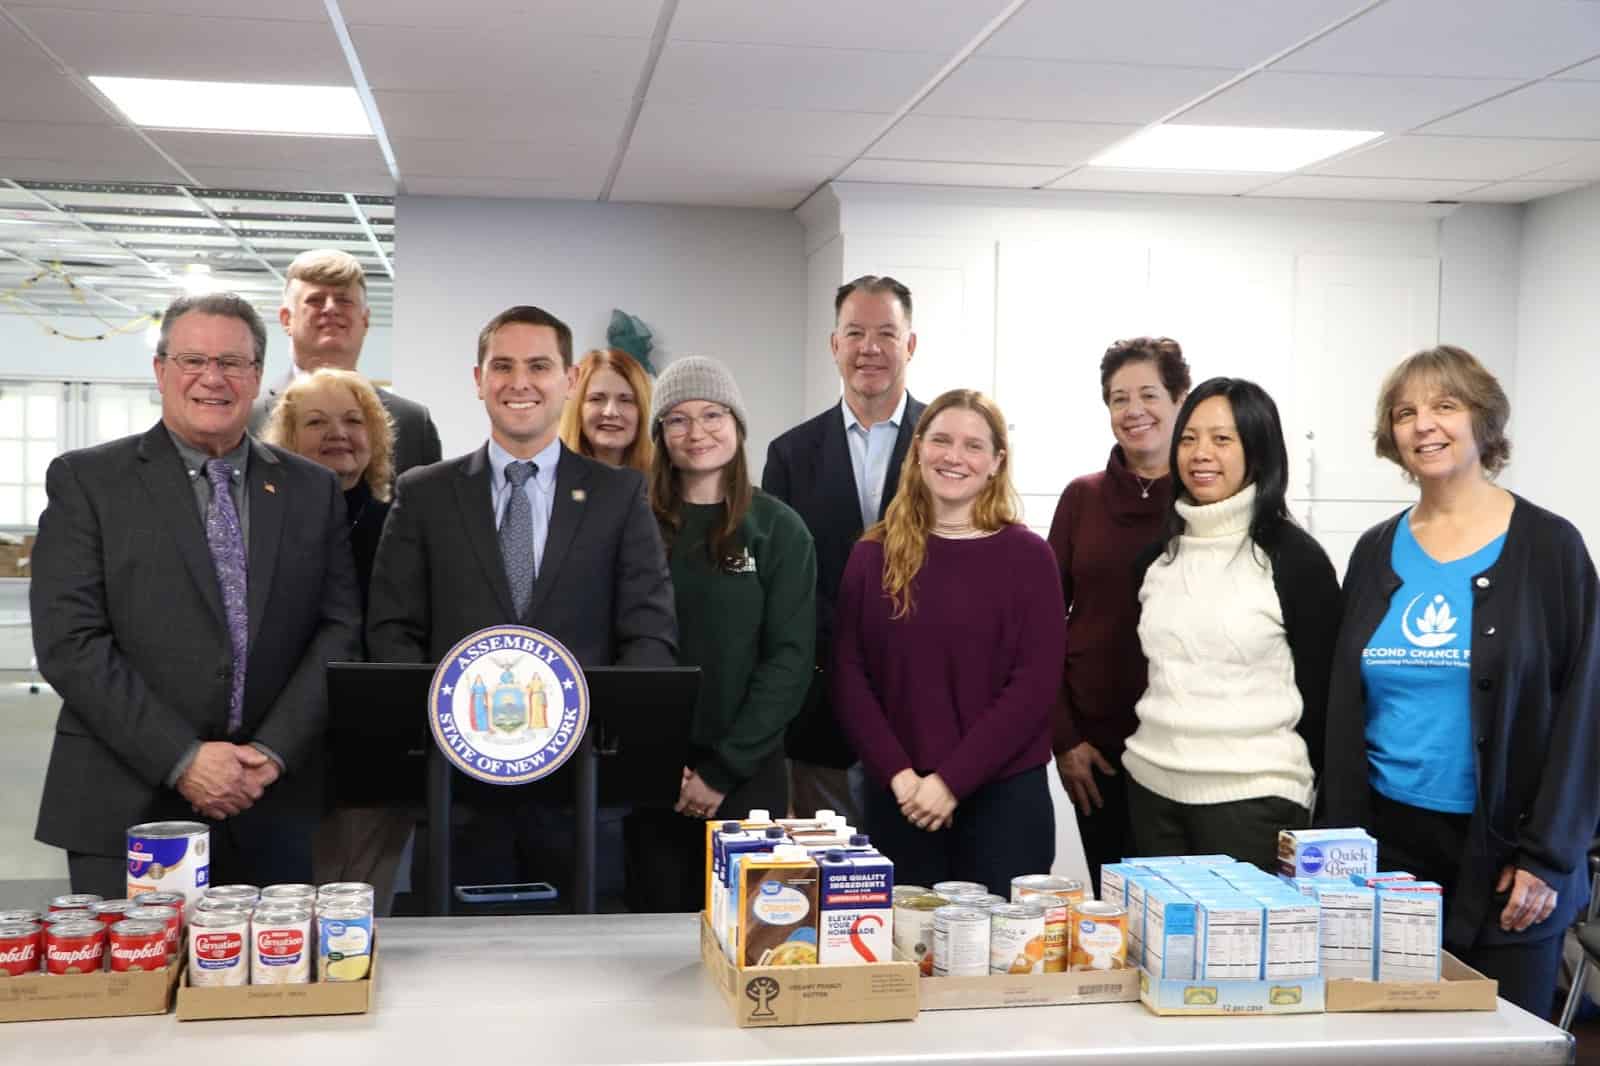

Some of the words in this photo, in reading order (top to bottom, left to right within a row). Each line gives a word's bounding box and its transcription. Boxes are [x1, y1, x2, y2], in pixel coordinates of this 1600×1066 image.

[458, 636, 560, 670] ASSEMBLY
[1362, 648, 1407, 657] ECOND
[1410, 648, 1460, 658] CHANCE
[440, 713, 474, 762] STATE
[478, 757, 503, 773] OF
[506, 752, 547, 774] NEW
[549, 708, 577, 754] YORK
[1330, 847, 1369, 863] Quick
[830, 881, 885, 889] INGREDIENTS
[849, 873, 887, 881] QUALITY
[828, 914, 860, 922] ELEVATE
[48, 943, 103, 964] Campbell's
[111, 940, 165, 963] Campbell's
